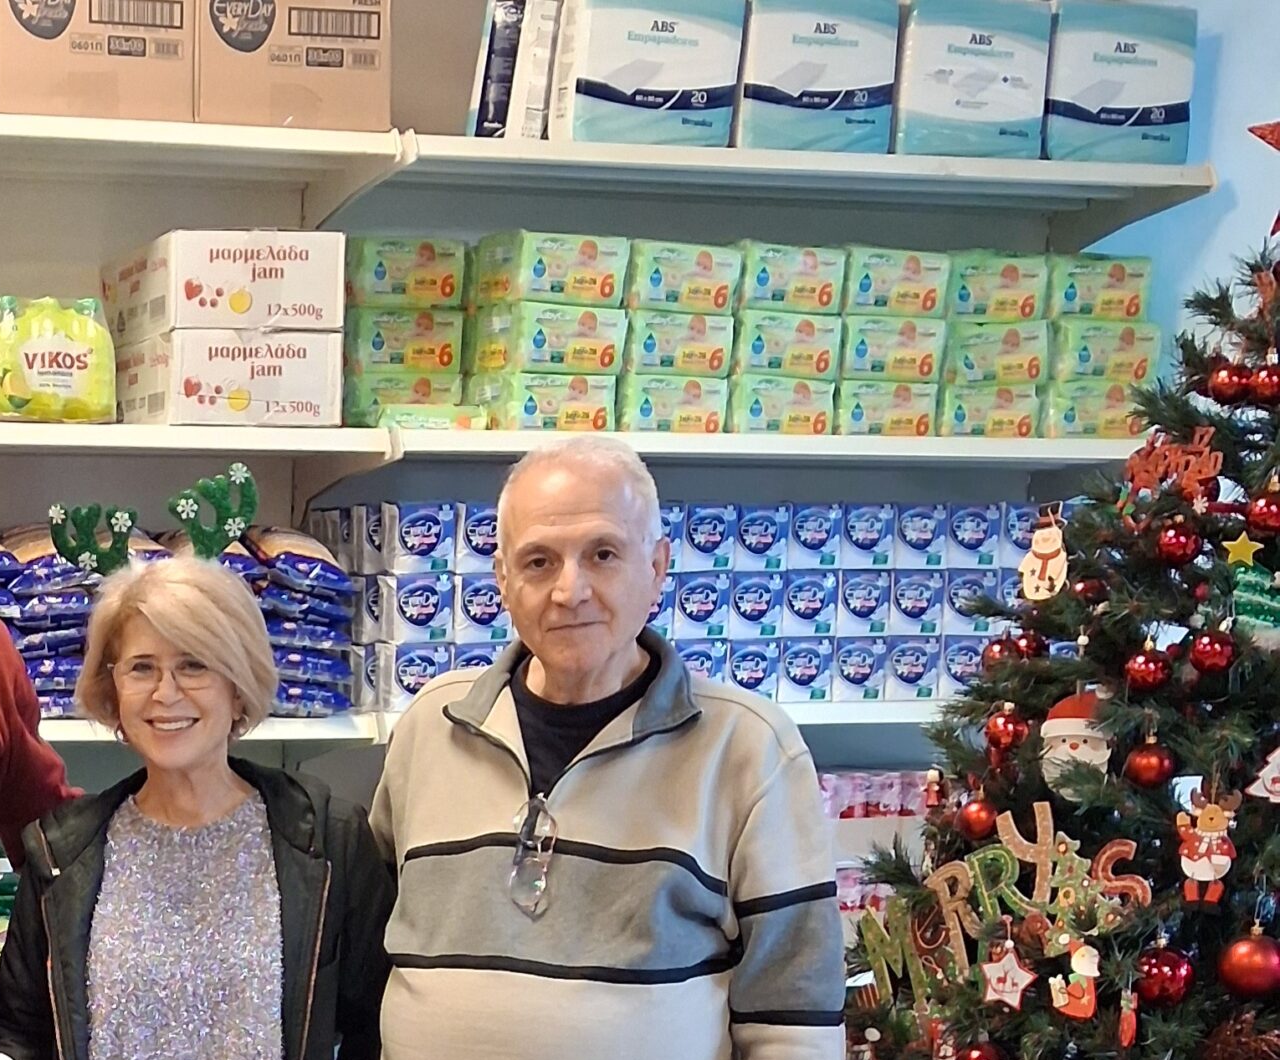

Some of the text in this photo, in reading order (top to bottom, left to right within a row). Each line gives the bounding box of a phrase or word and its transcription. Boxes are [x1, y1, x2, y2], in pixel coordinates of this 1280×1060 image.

[650, 20, 676, 34] ABS
[814, 22, 838, 35] ABS
[968, 33, 994, 47] ABS
[1114, 41, 1137, 54] ABS
[690, 90, 708, 104] 20
[853, 90, 869, 104] 20
[209, 246, 310, 266] μαρμελάδα
[251, 263, 285, 282] jam
[439, 273, 455, 298] 6
[599, 274, 613, 298] 6
[713, 284, 728, 307] 6
[817, 284, 831, 305] 6
[921, 289, 936, 309] 6
[1019, 296, 1034, 316] 6
[1125, 295, 1139, 314] 6
[24, 351, 89, 371] VIKOS
[208, 344, 308, 362] μαρμελάδα
[437, 341, 453, 368] 6
[599, 343, 614, 368] 6
[709, 349, 723, 369] 6
[815, 350, 830, 371] 6
[250, 361, 283, 380] jam
[918, 355, 932, 375] 6
[1027, 358, 1040, 377] 6
[1134, 360, 1147, 377] 6
[590, 407, 606, 431] 6
[704, 415, 719, 433] 6
[812, 414, 826, 435] 6
[915, 415, 929, 437] 6
[1015, 418, 1031, 437] 6
